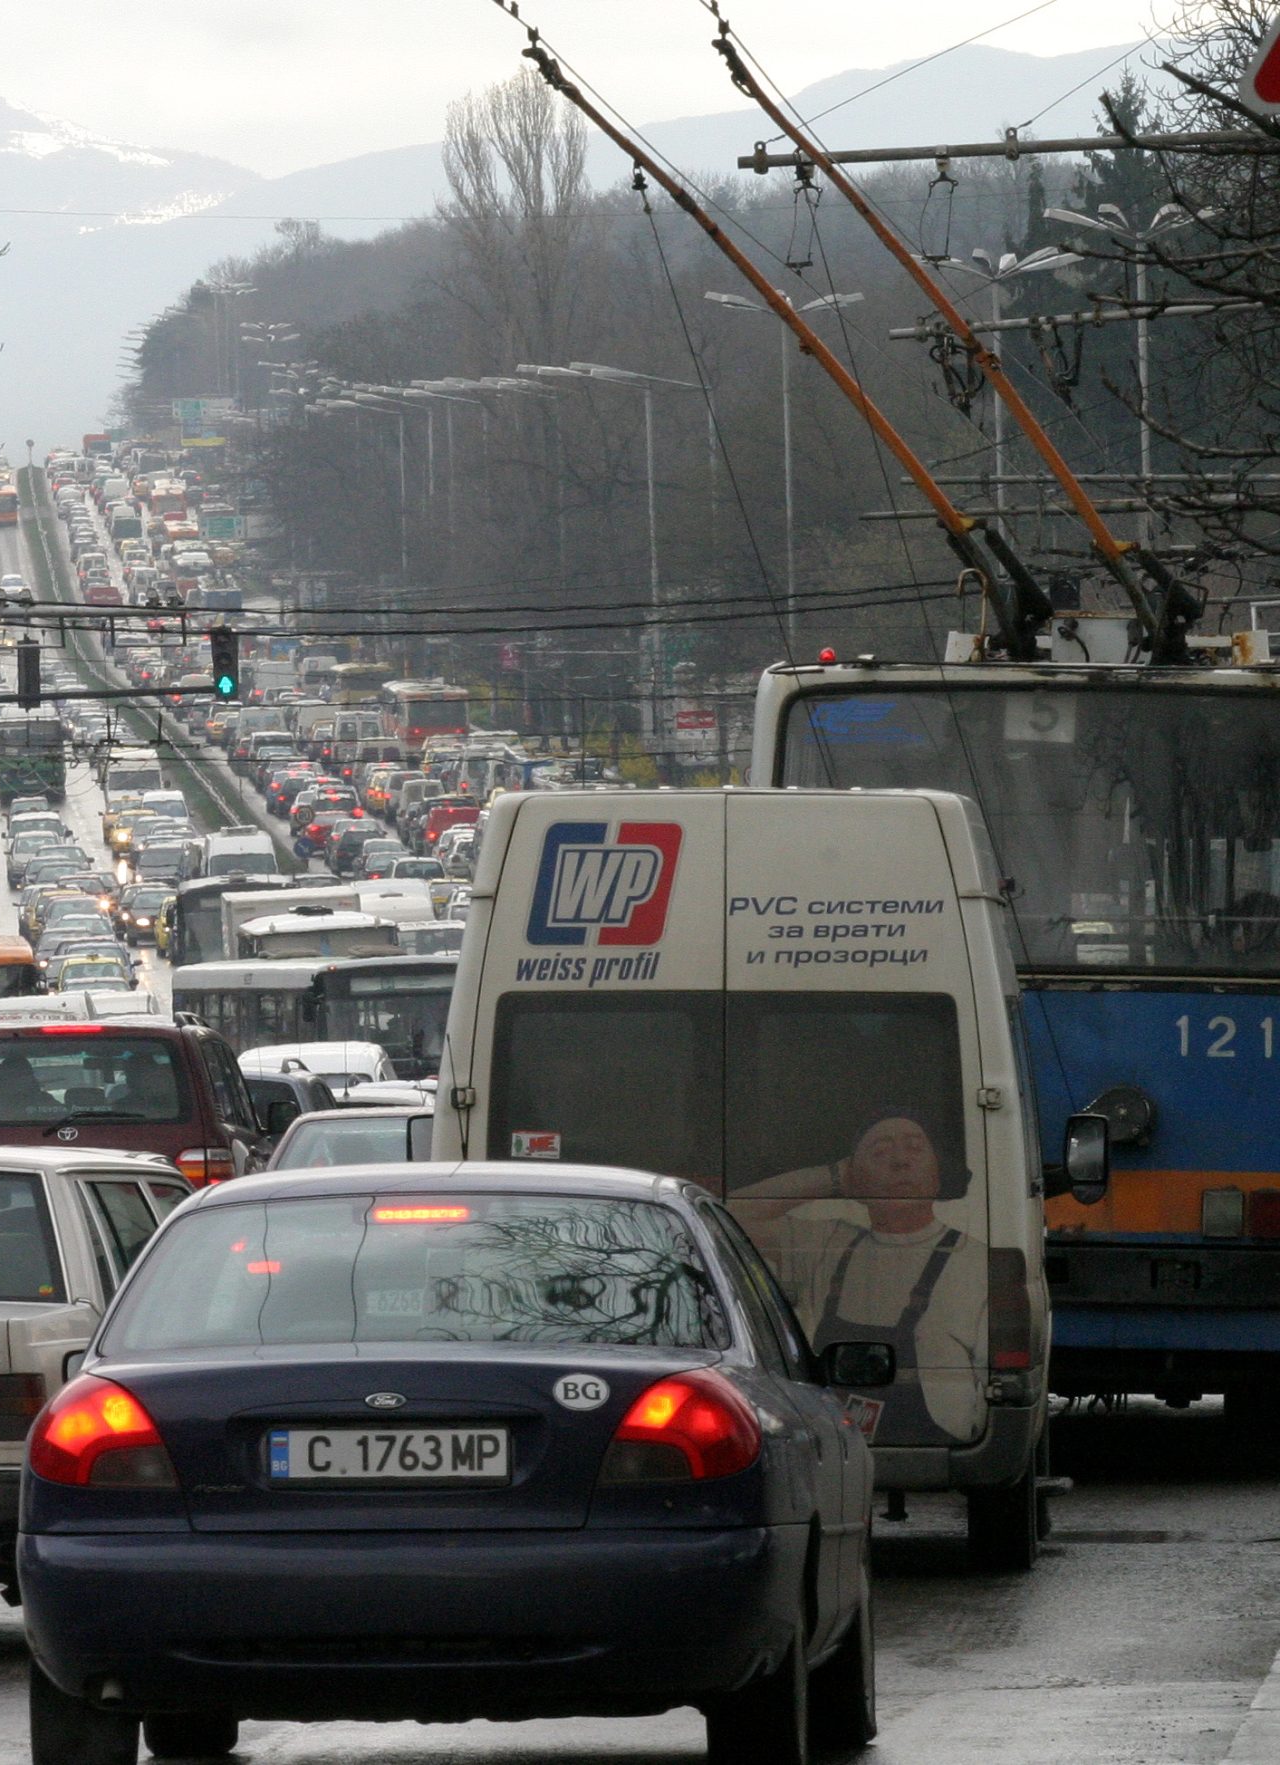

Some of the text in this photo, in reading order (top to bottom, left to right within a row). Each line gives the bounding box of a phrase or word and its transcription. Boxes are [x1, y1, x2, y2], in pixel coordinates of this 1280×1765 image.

[549, 849, 658, 925] WP
[728, 896, 945, 917] PVC системи
[768, 921, 906, 942] за врати
[746, 946, 929, 969] и прозорци
[516, 951, 660, 988] weiss profil
[561, 1380, 602, 1402] BG
[307, 1433, 501, 1473] C 1763 MP
[271, 1459, 289, 1472] BG
